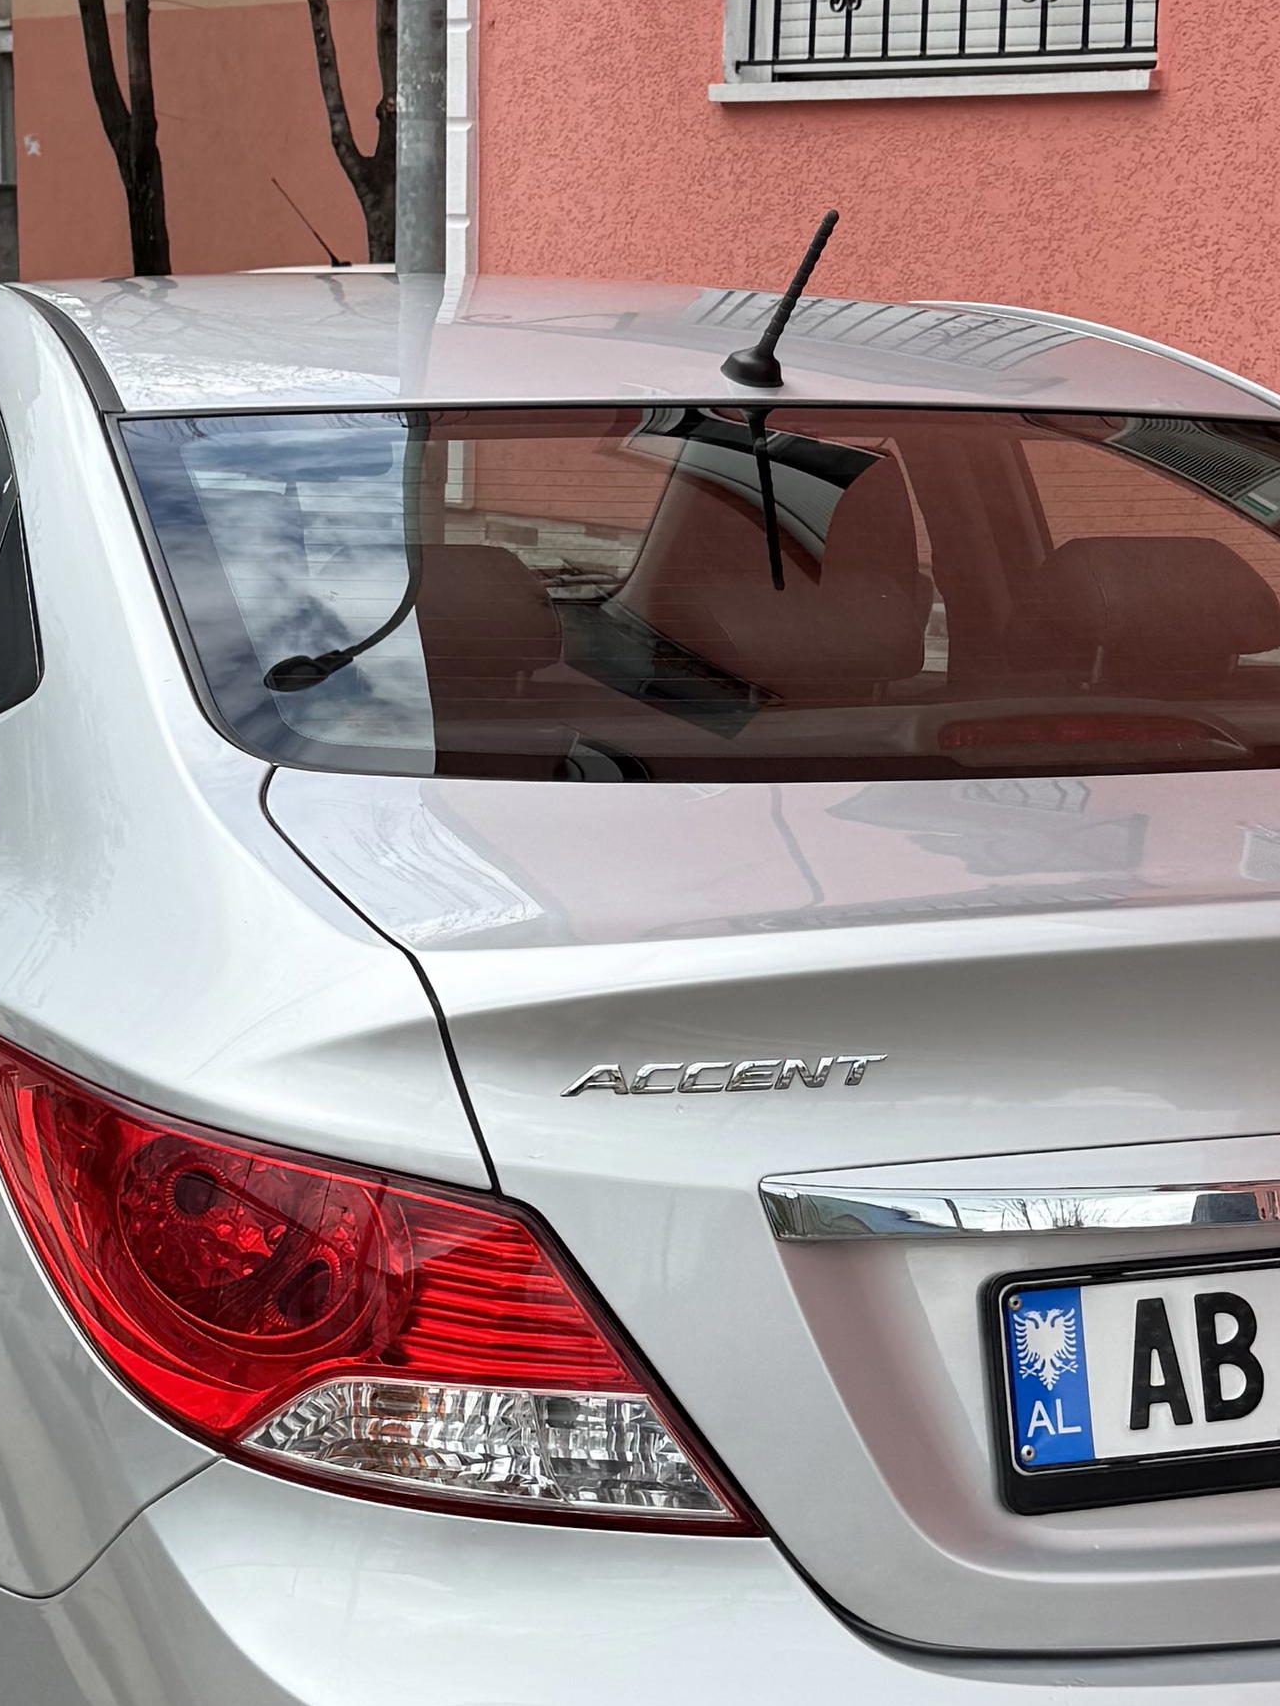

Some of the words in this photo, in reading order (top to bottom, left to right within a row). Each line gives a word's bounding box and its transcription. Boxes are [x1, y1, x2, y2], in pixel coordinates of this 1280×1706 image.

[560, 1053, 888, 1097] ACCENT
[1128, 1292, 1265, 1431] AB
[1026, 1398, 1082, 1438] AL
